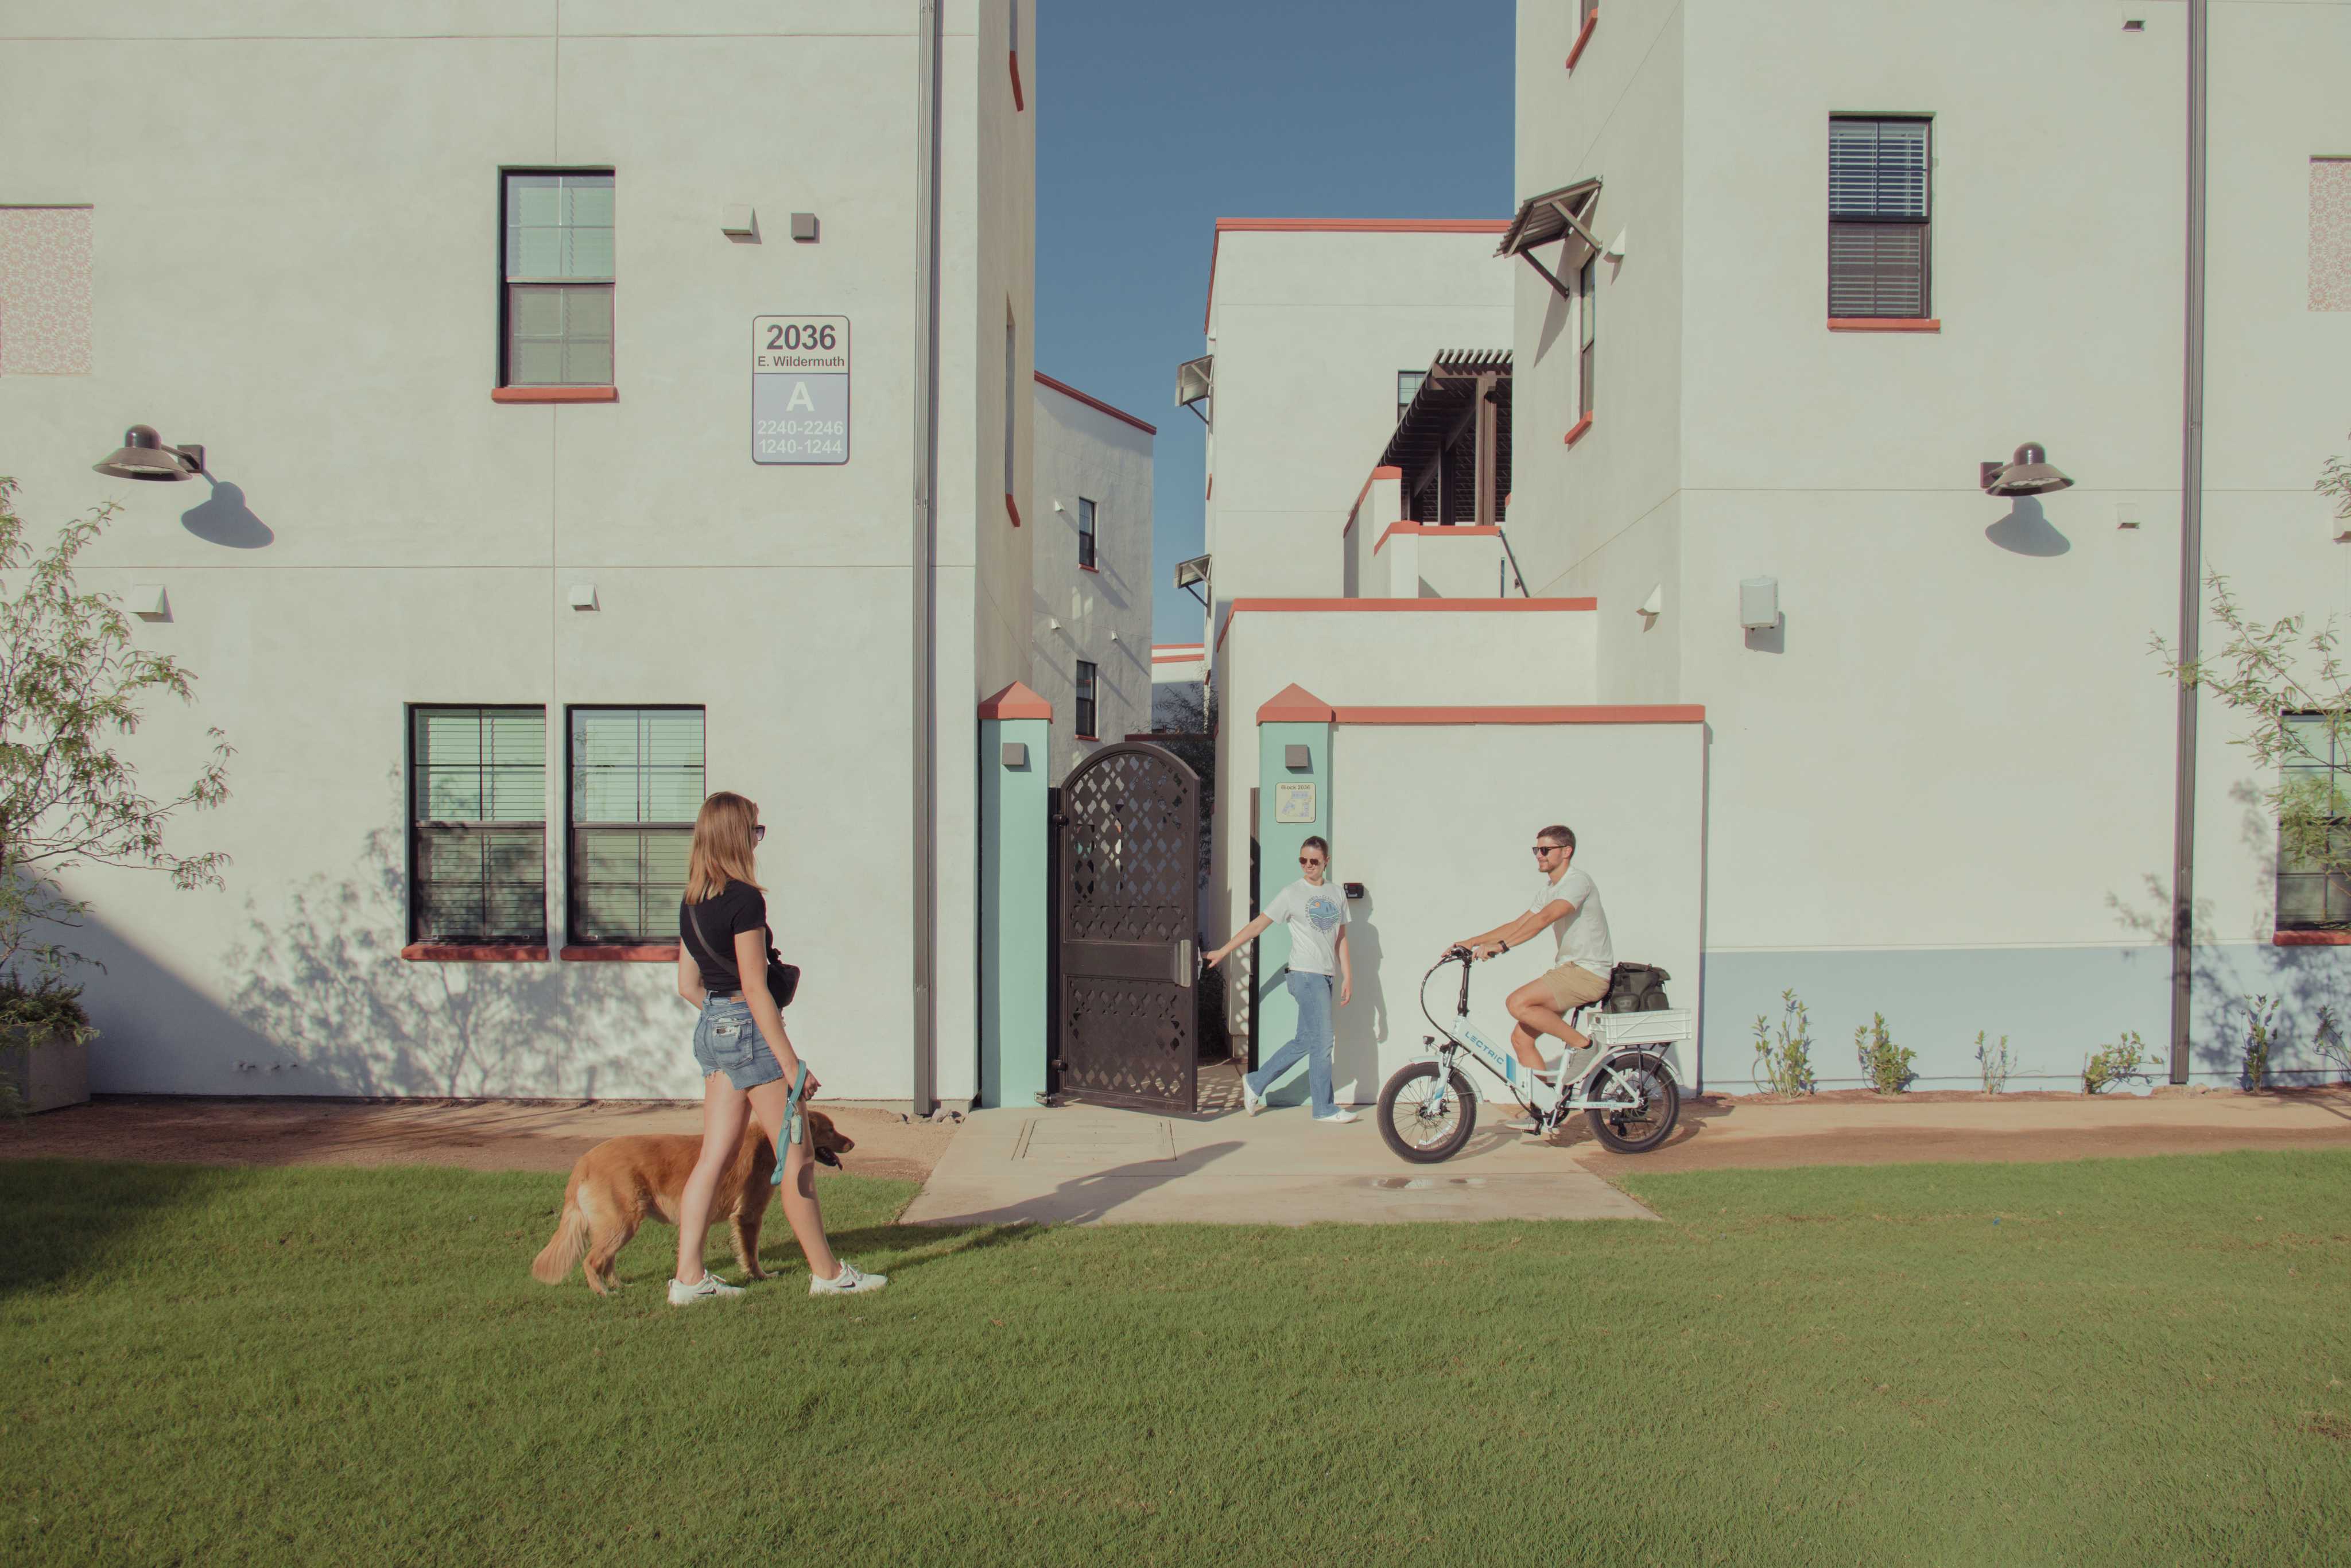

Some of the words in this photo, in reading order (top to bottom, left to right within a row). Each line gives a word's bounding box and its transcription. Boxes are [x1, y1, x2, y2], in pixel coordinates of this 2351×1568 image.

[766, 324, 836, 350] 2036
[758, 356, 769, 367] E.
[774, 355, 845, 367] Wildermuth
[786, 381, 815, 412] A
[757, 420, 844, 435] 2240-2246
[758, 439, 843, 454] 1240-1244
[1465, 1031, 1504, 1065] LECTRIC
